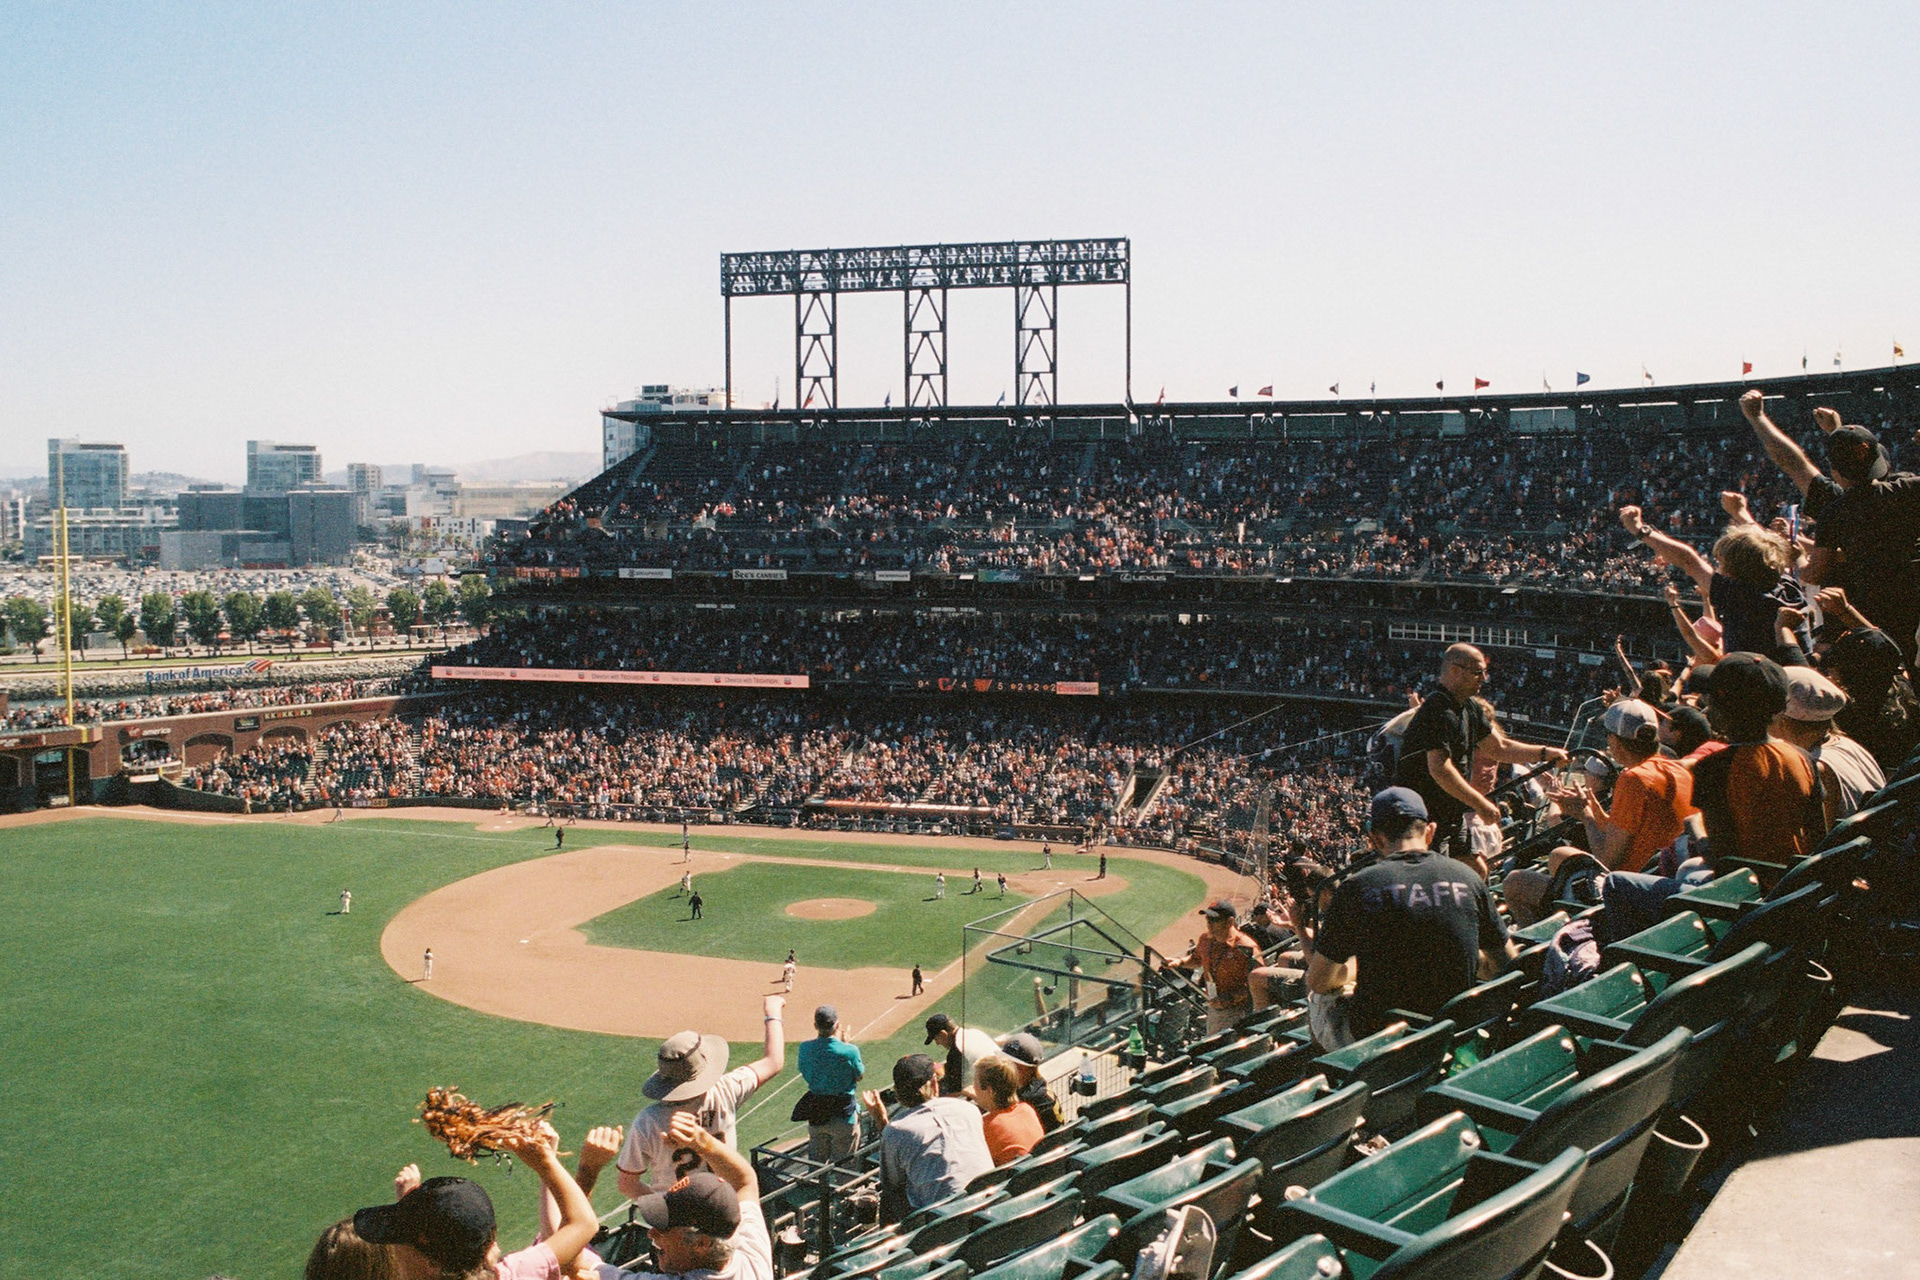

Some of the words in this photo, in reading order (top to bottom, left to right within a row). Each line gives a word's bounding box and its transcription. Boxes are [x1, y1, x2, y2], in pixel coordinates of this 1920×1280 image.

[734, 570, 755, 578] See's
[146, 669, 178, 682] Bank
[180, 668, 190, 679] of
[192, 666, 243, 678] America
[1363, 881, 1469, 910] STAFF
